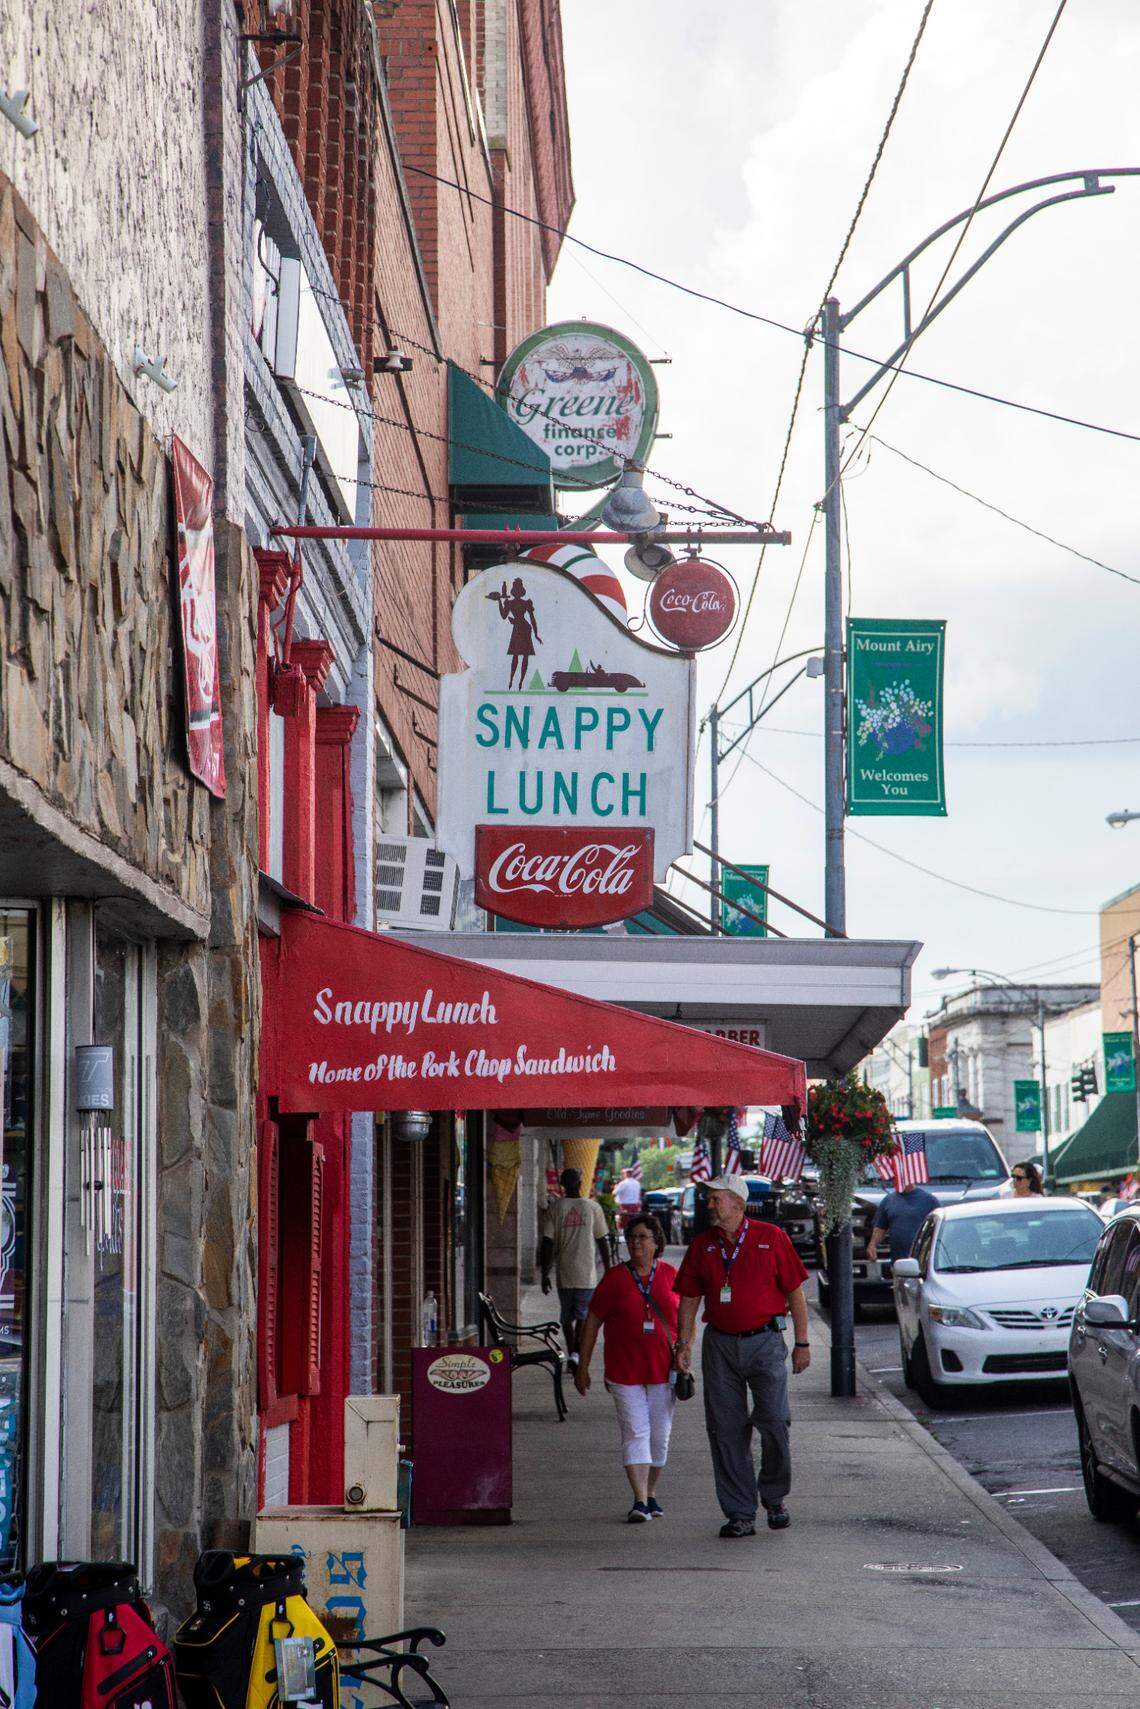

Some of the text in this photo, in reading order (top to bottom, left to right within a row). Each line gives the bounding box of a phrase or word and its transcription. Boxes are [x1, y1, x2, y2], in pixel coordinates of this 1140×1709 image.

[514, 387, 635, 425] Greene
[543, 423, 617, 440] finance
[554, 442, 603, 459] corp.
[660, 588, 722, 613] Coca-Cola
[856, 637, 935, 655] Mount Airy
[475, 702, 664, 752] SNAPPY
[860, 768, 929, 782] Welcomes
[881, 783, 908, 796] You
[486, 770, 647, 816] LUNCH
[488, 842, 643, 896] Coca-Cola
[313, 987, 500, 1035] Snappy Lunch
[308, 1060, 361, 1085] Home
[388, 1054, 418, 1081] the
[421, 1050, 461, 1079] Pork
[464, 1049, 511, 1083] Chop
[514, 1044, 617, 1077] Sandwich
